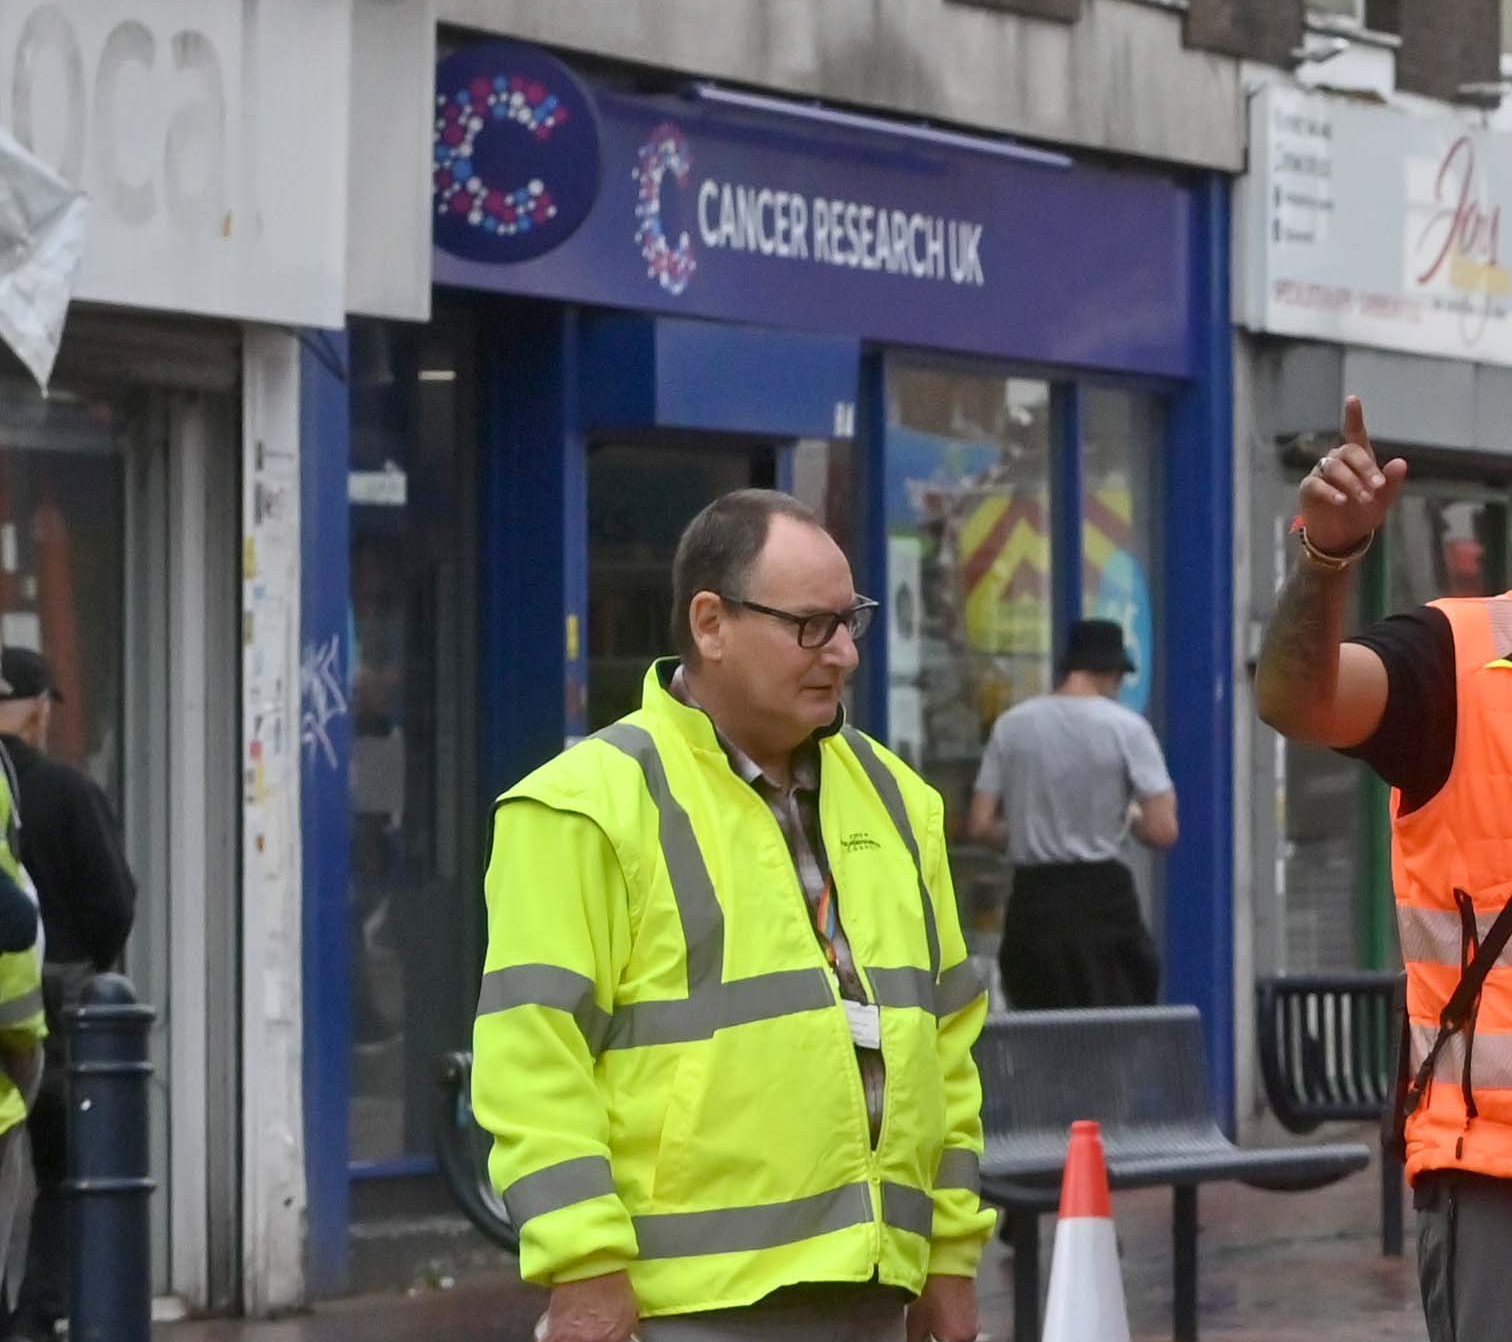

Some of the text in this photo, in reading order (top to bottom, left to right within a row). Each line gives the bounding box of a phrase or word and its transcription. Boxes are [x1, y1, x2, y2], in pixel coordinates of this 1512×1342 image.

[699, 177, 985, 287] CANCER RESEARCH UK
